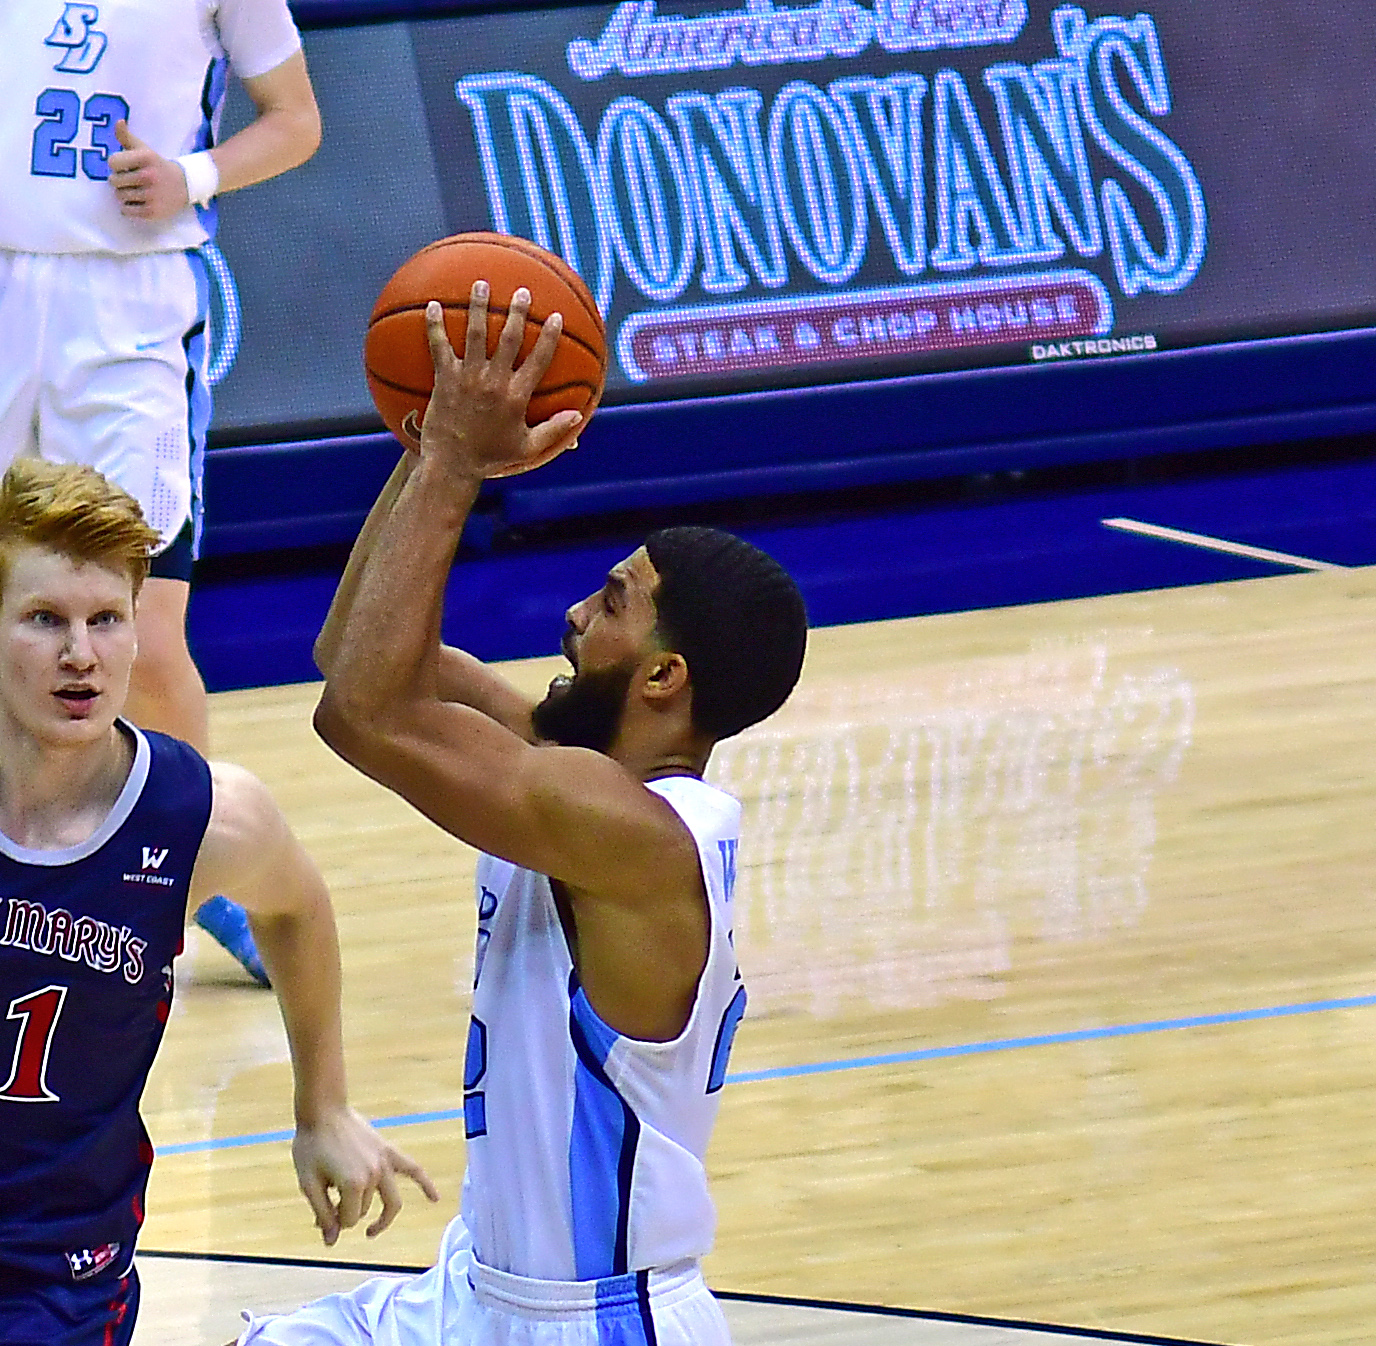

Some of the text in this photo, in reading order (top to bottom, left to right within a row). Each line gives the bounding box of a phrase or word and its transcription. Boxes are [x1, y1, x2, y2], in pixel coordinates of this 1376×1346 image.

[31, 88, 130, 182] 23
[456, 3, 1208, 322] DONOVAN'S
[649, 323, 781, 365] STEAK
[831, 308, 938, 347] CHOP
[948, 293, 1080, 335] HOUSE
[1031, 334, 1158, 361] DAKTRONICS
